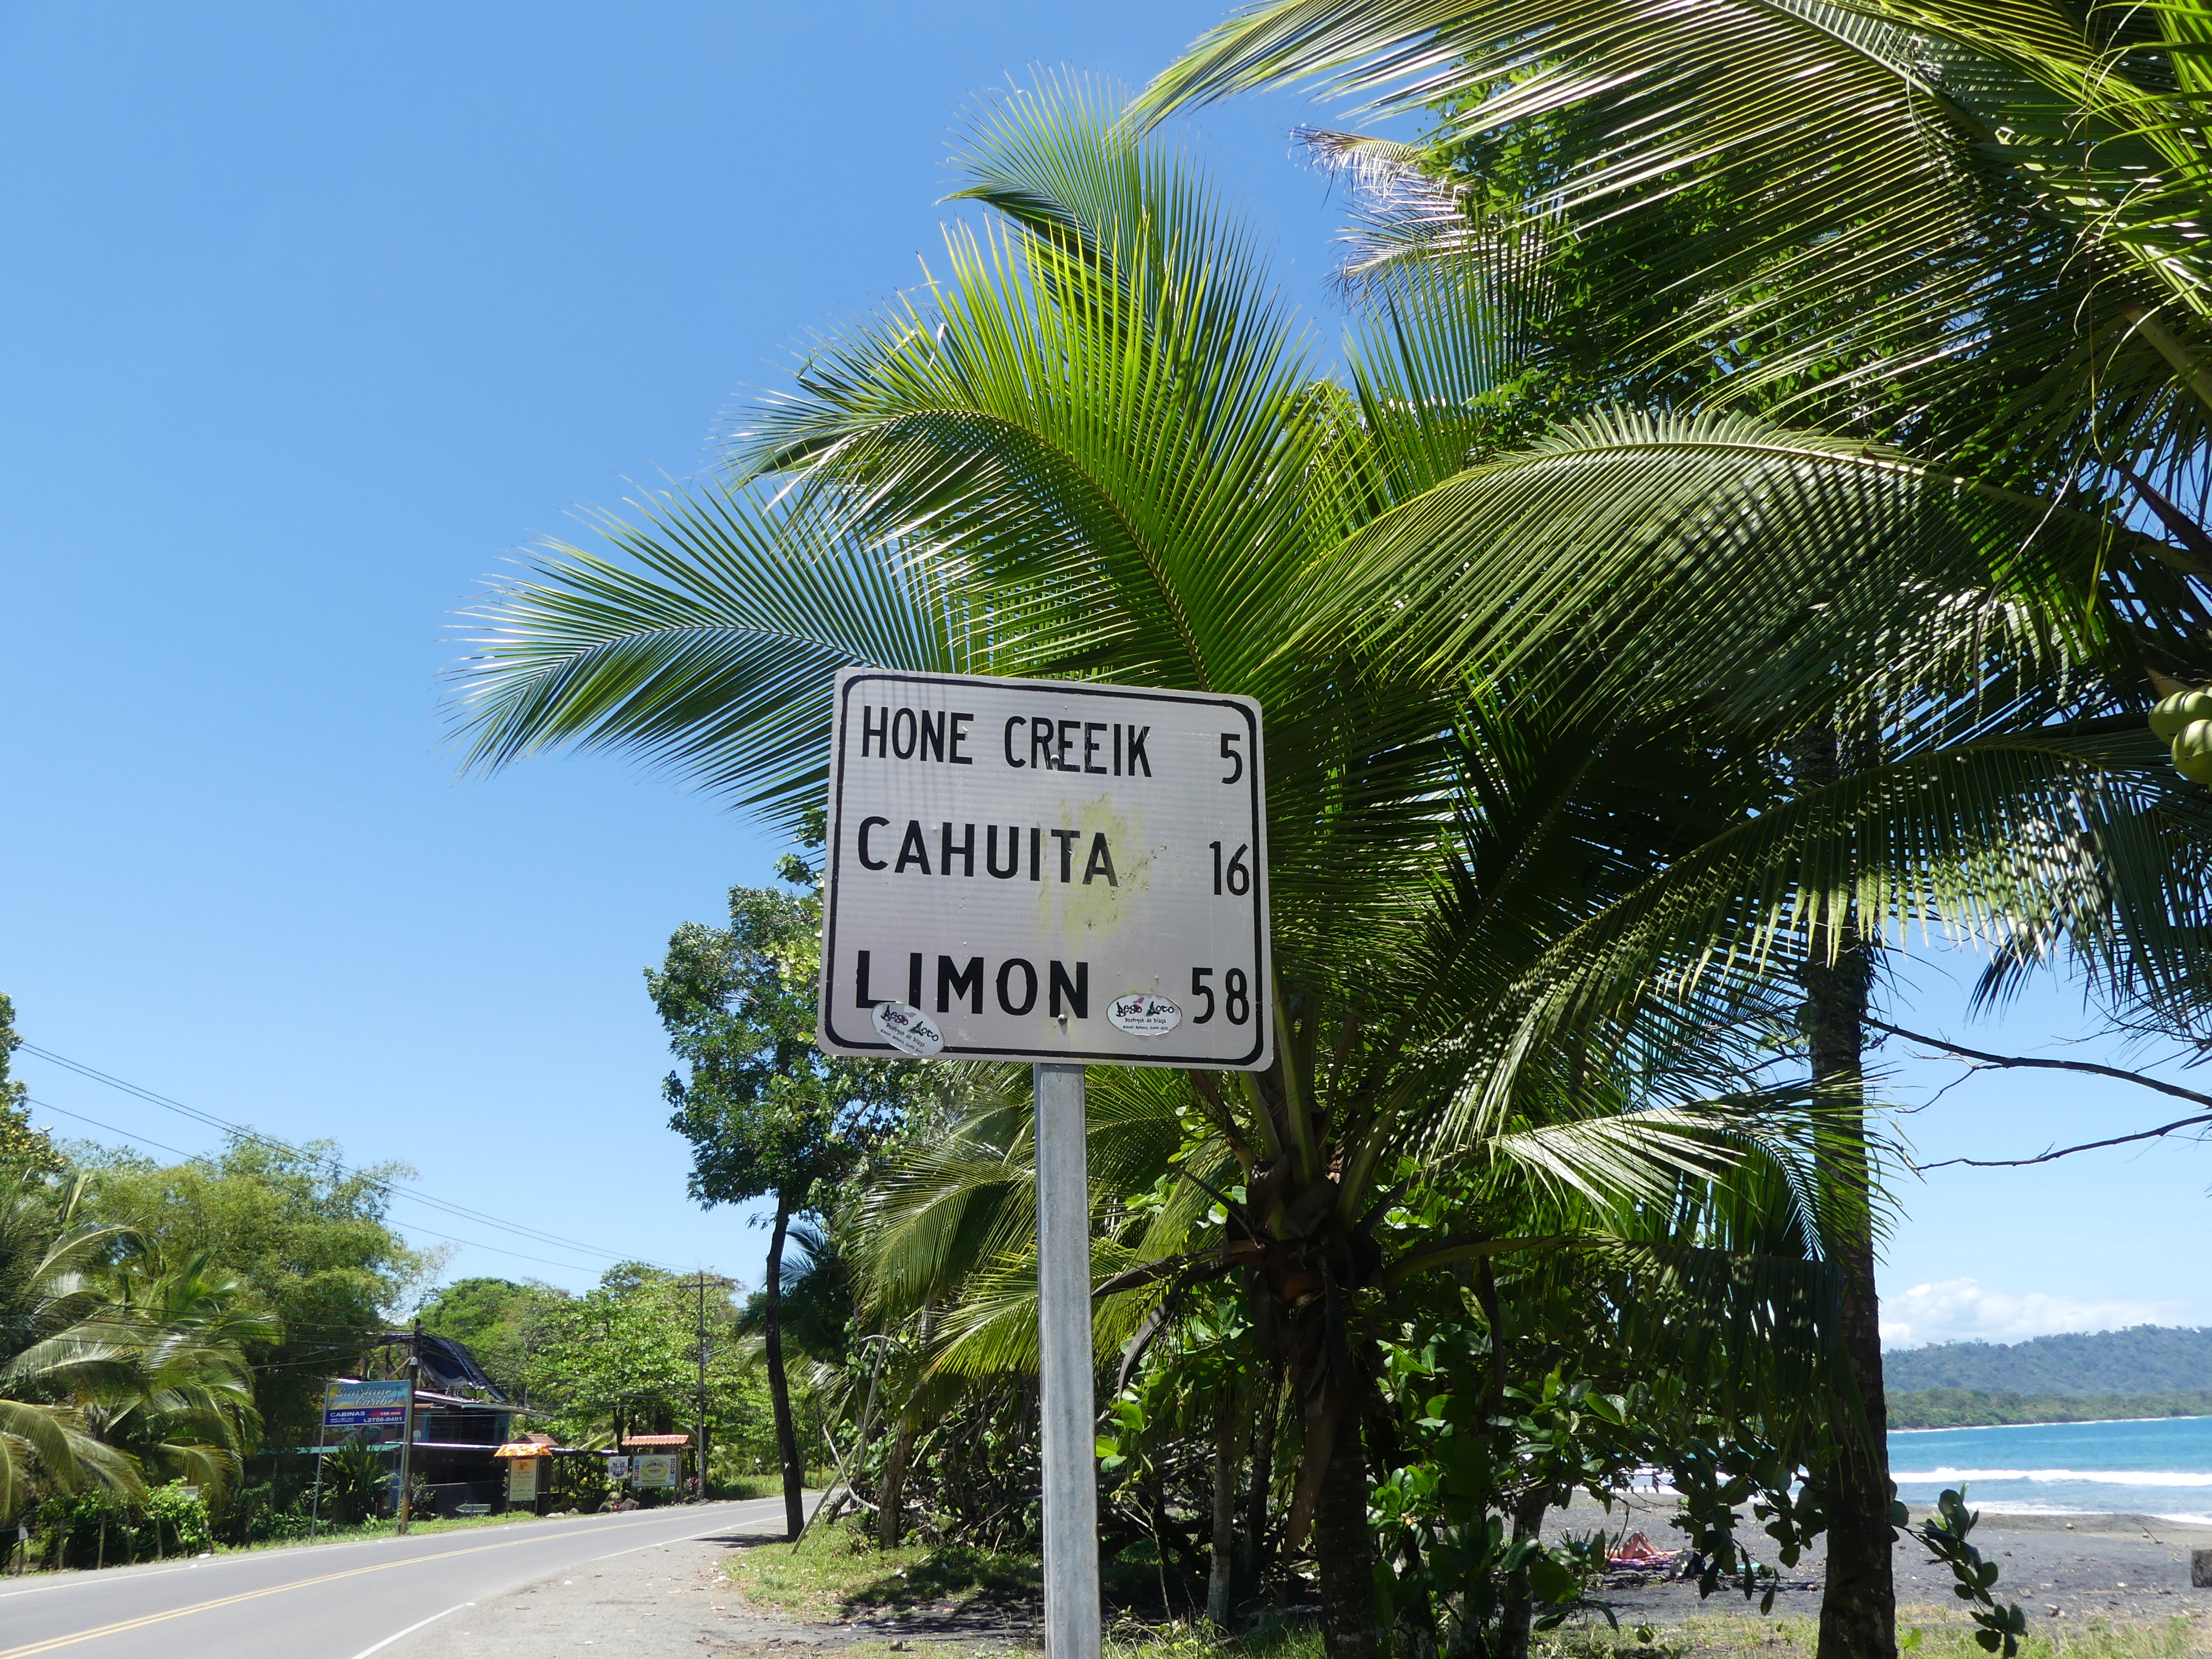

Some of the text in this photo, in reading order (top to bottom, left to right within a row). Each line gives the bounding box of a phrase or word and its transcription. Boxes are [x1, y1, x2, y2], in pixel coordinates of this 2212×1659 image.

[862, 705, 1243, 785] HONE CREEIK 5
[858, 816, 1250, 896] CAHUITA 16
[855, 950, 1250, 1025] LIMON 58
[336, 1385, 393, 1398] Sunshine
[355, 1395, 395, 1407] Caribe
